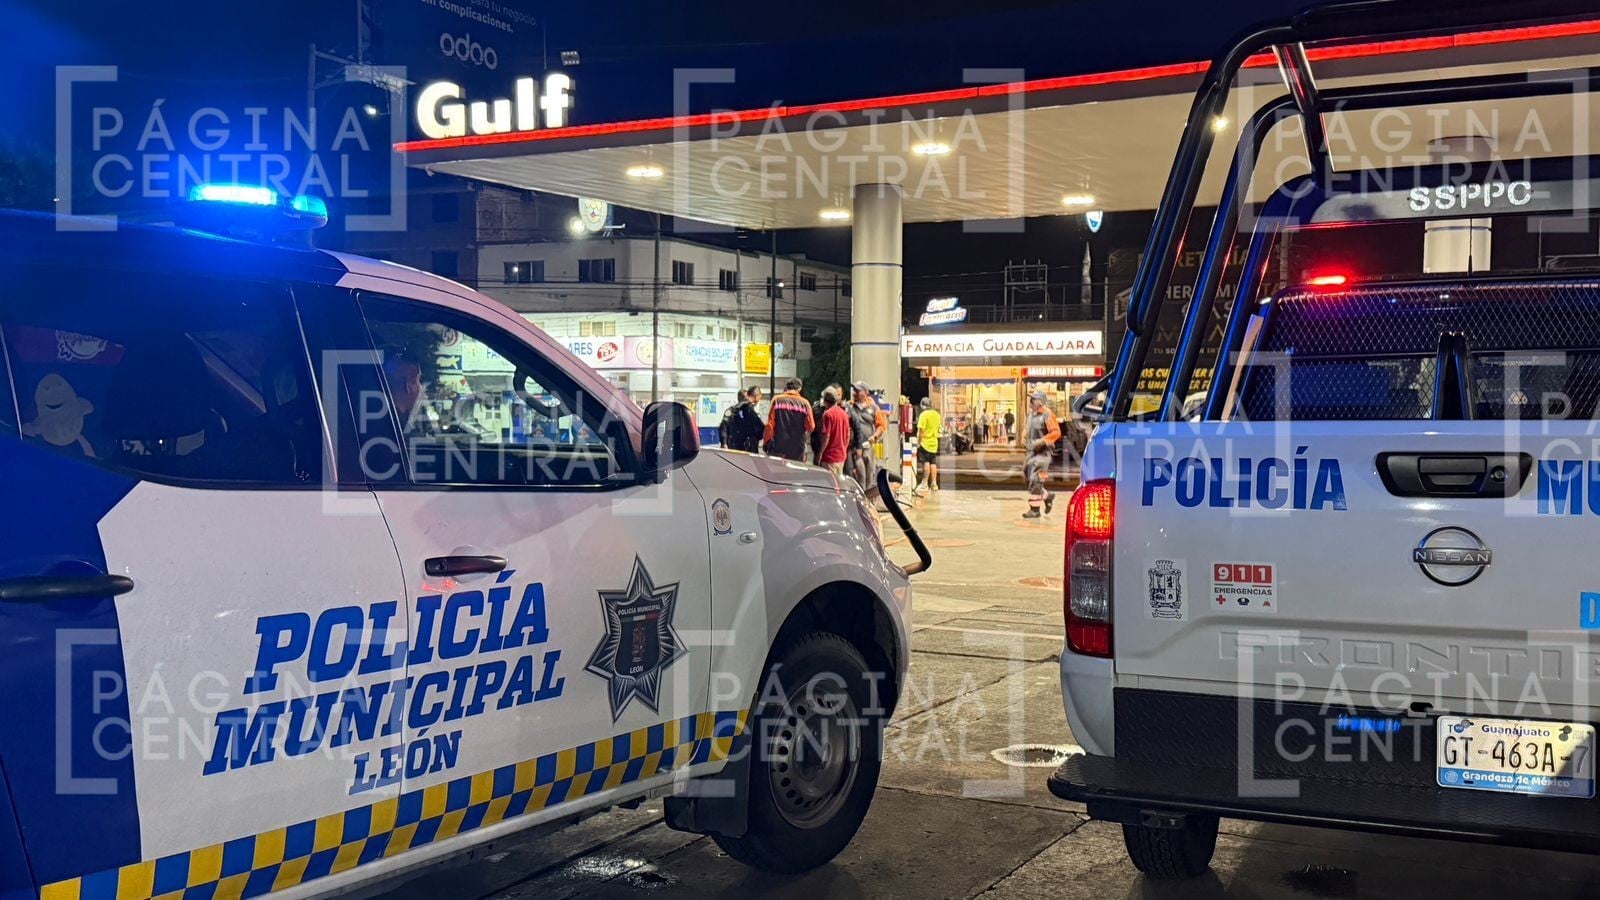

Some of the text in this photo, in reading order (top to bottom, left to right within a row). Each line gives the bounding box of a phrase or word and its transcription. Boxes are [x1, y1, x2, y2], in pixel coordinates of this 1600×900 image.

[439, 32, 498, 70] odoo
[417, 73, 574, 139] Gulf
[1409, 180, 1532, 212] SSPPC
[905, 338, 1096, 353] FARMACIA GUADALAJARA
[1141, 445, 1348, 512] POLICÍA
[1415, 551, 1489, 562] NISSAN
[1216, 564, 1269, 582] 911
[1213, 587, 1273, 596] EMERGENCIAS
[618, 604, 661, 617] POLICÍA MUNICIPAL
[243, 569, 550, 695] POLICÍA
[202, 650, 565, 776] MUNICIPAL
[1481, 724, 1551, 737] Guanajuato
[349, 728, 462, 795] LEÓN
[1462, 771, 1513, 784] Grandeza
[1515, 775, 1529, 785] de
[1531, 775, 1571, 788] México
